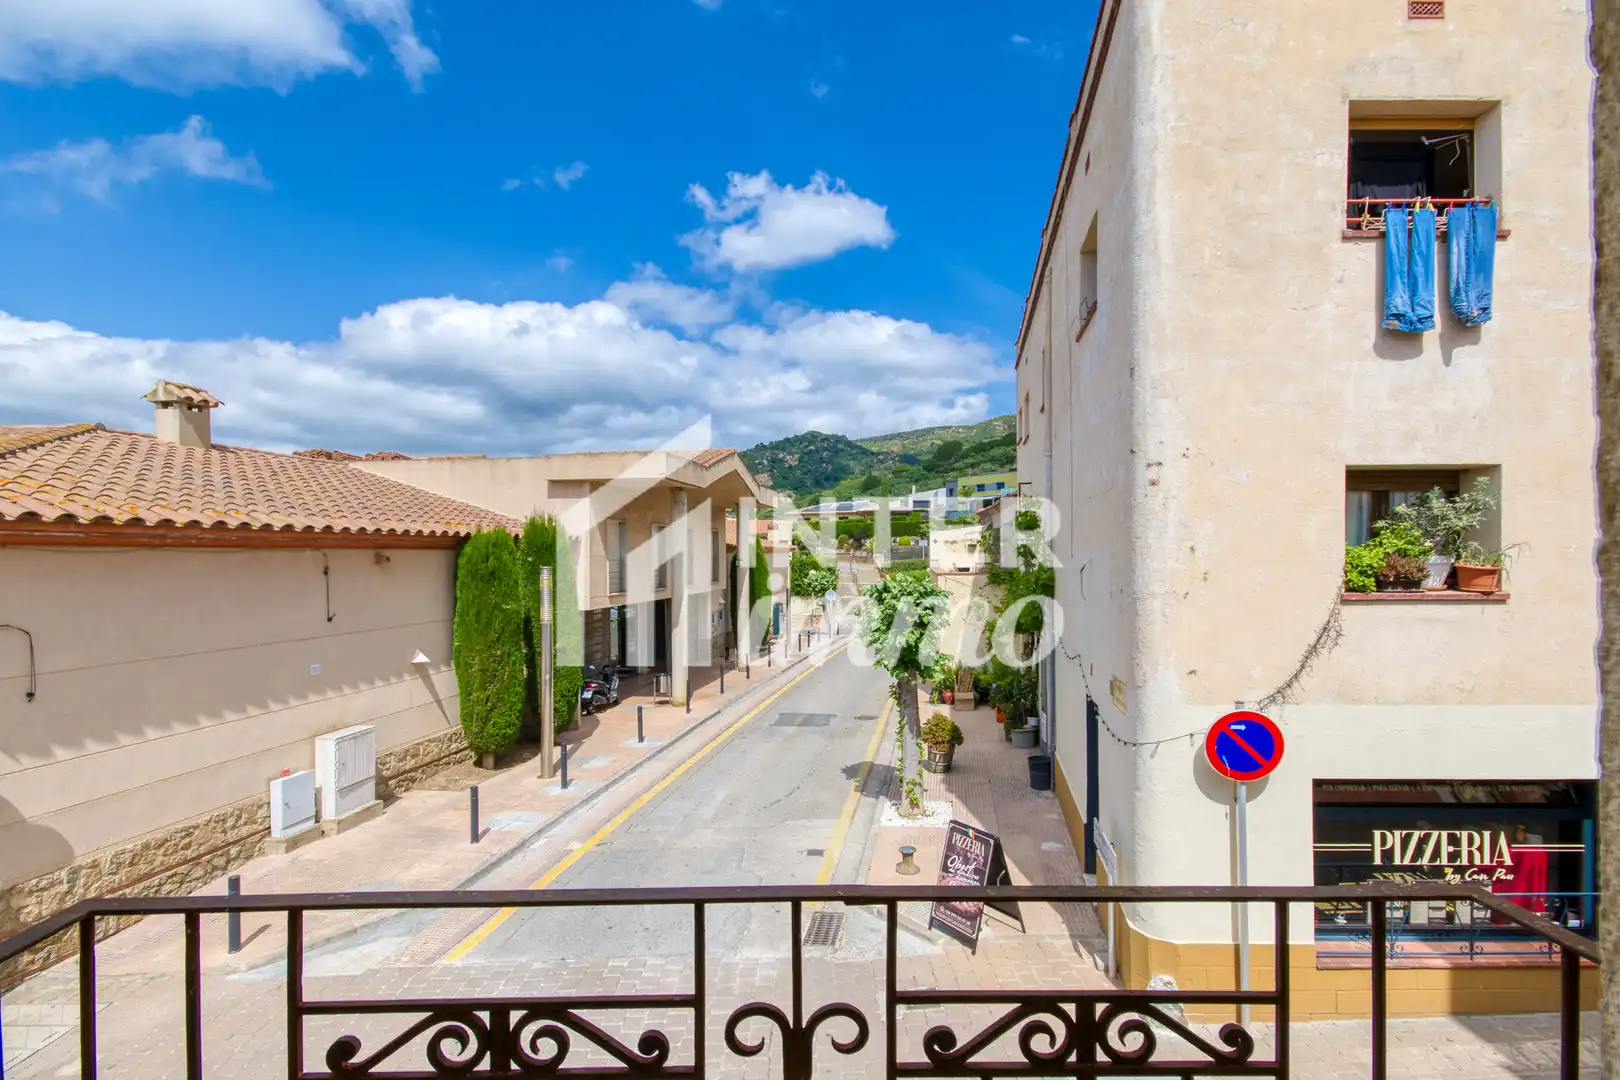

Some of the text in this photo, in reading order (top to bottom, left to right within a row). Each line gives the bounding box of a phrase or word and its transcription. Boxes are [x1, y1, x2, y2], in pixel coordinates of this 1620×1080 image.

[952, 832, 985, 857] PIZZERIA
[1372, 830, 1514, 866] PIZZERIA
[1445, 868, 1461, 884] by
[1465, 868, 1489, 881] Can
